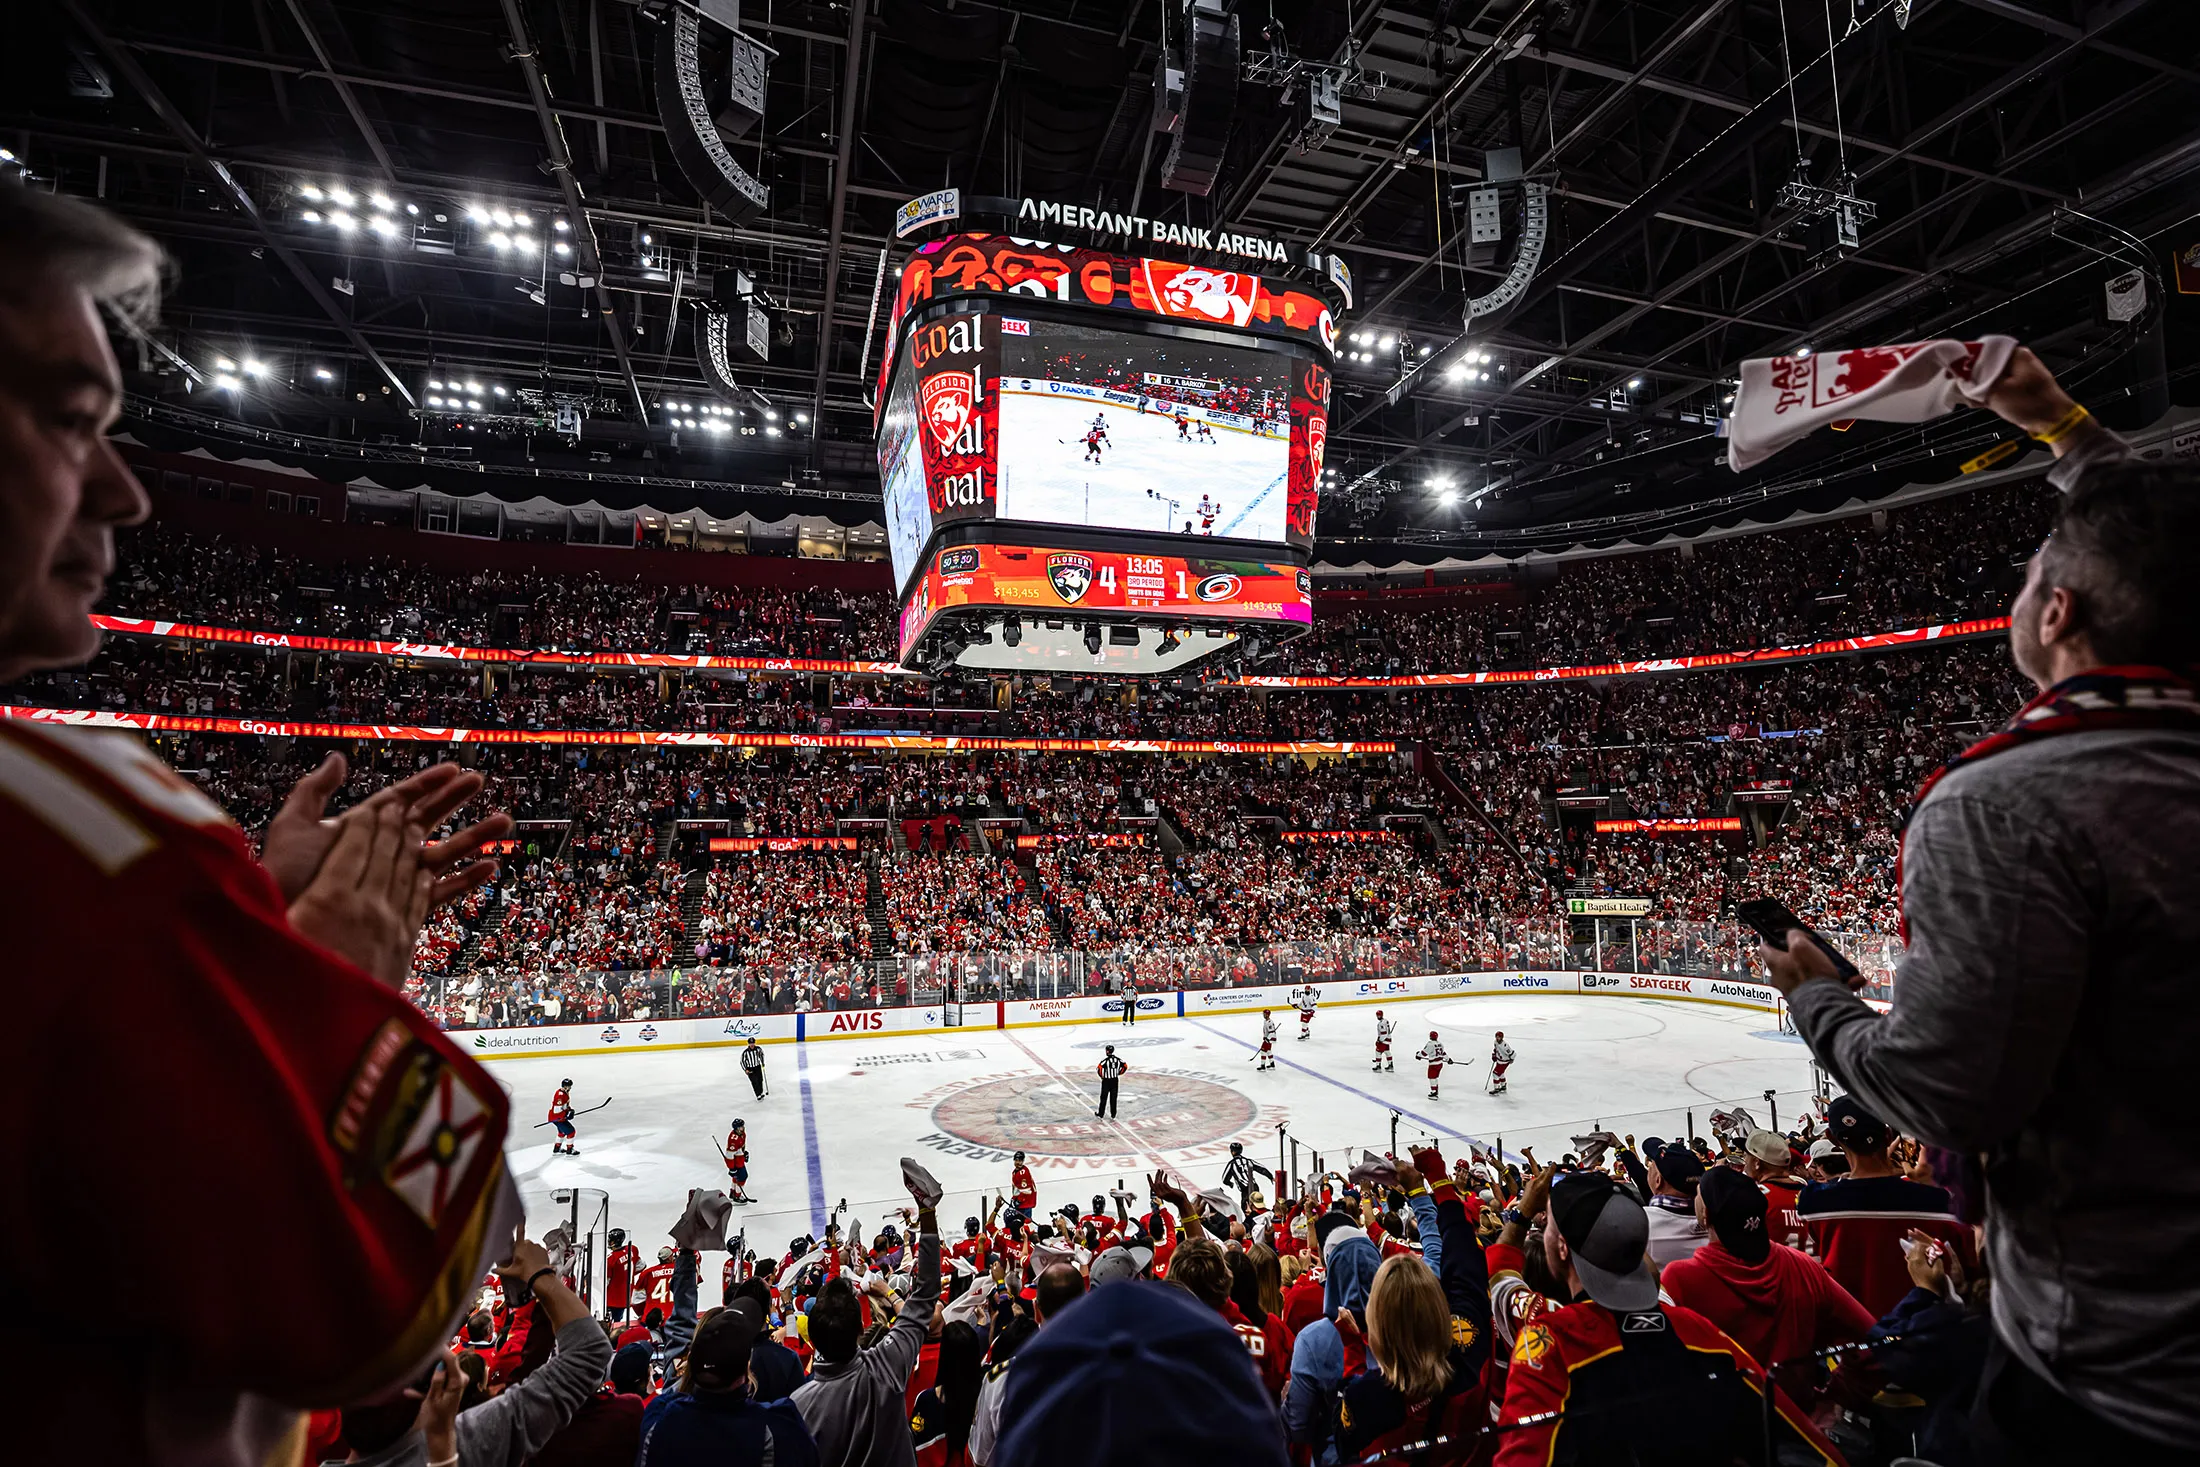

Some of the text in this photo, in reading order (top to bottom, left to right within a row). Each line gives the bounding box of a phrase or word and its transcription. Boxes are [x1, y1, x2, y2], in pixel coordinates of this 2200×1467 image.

[899, 192, 954, 222] BROWARD
[920, 203, 954, 215] COUTY
[1018, 198, 1289, 264] AMERANT BANK ARENA
[912, 314, 985, 368] Goal
[925, 377, 966, 398] FLORIDA
[1181, 380, 1206, 388] BARKOV
[1062, 386, 1096, 396] FANDUEL
[1103, 390, 1137, 403] Energizer
[1051, 557, 1088, 567] FLORIDA
[1127, 557, 1164, 575] 13:05
[1099, 566, 1117, 595] 4
[1129, 578, 1163, 587] 3RD PERIOD
[1176, 571, 1189, 599] 1
[994, 587, 1040, 599] $143,455
[1243, 601, 1283, 613] $143,455
[240, 720, 290, 736] GOAL
[790, 735, 826, 747] GOAL
[1214, 741, 1243, 753] GOAL
[1587, 903, 1617, 912] Baptist
[1439, 976, 1472, 986] OMEGA XL
[1439, 983, 1461, 991] SPORT
[1503, 974, 1549, 988] nextiva
[1630, 977, 1692, 993] SEATGEEK
[1711, 983, 1772, 1001] AutoNation
[1029, 1001, 1072, 1011] AMERANT
[1139, 998, 1161, 1009] Ford
[1041, 1011, 1061, 1019] BANK
[724, 1020, 761, 1034] LaCroix
[830, 1012, 883, 1033] AVIS
[488, 1035, 559, 1048] idealnutrition
[1024, 1155, 1137, 1170] BANK
